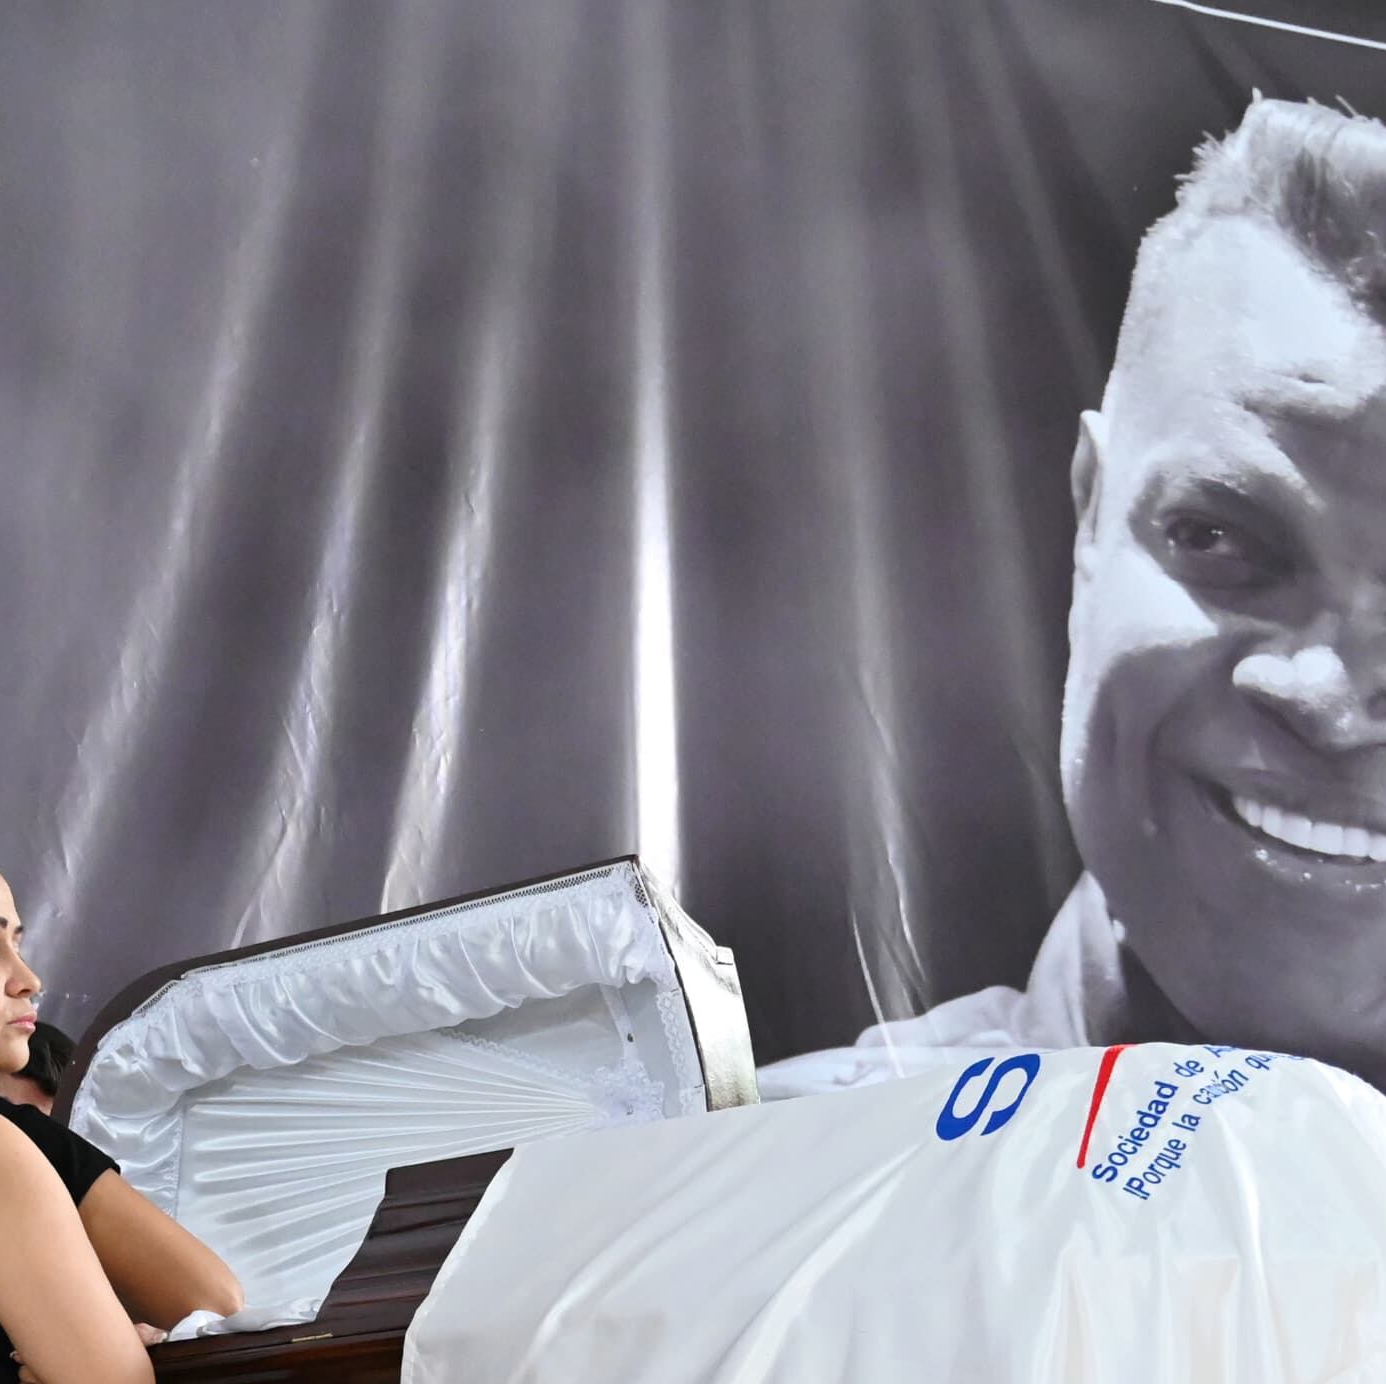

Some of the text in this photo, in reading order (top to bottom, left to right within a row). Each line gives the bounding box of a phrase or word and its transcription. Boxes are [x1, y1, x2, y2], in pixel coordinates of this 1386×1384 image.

[1091, 1059, 1205, 1183] Sociedad de
[1171, 1111, 1202, 1133] la
